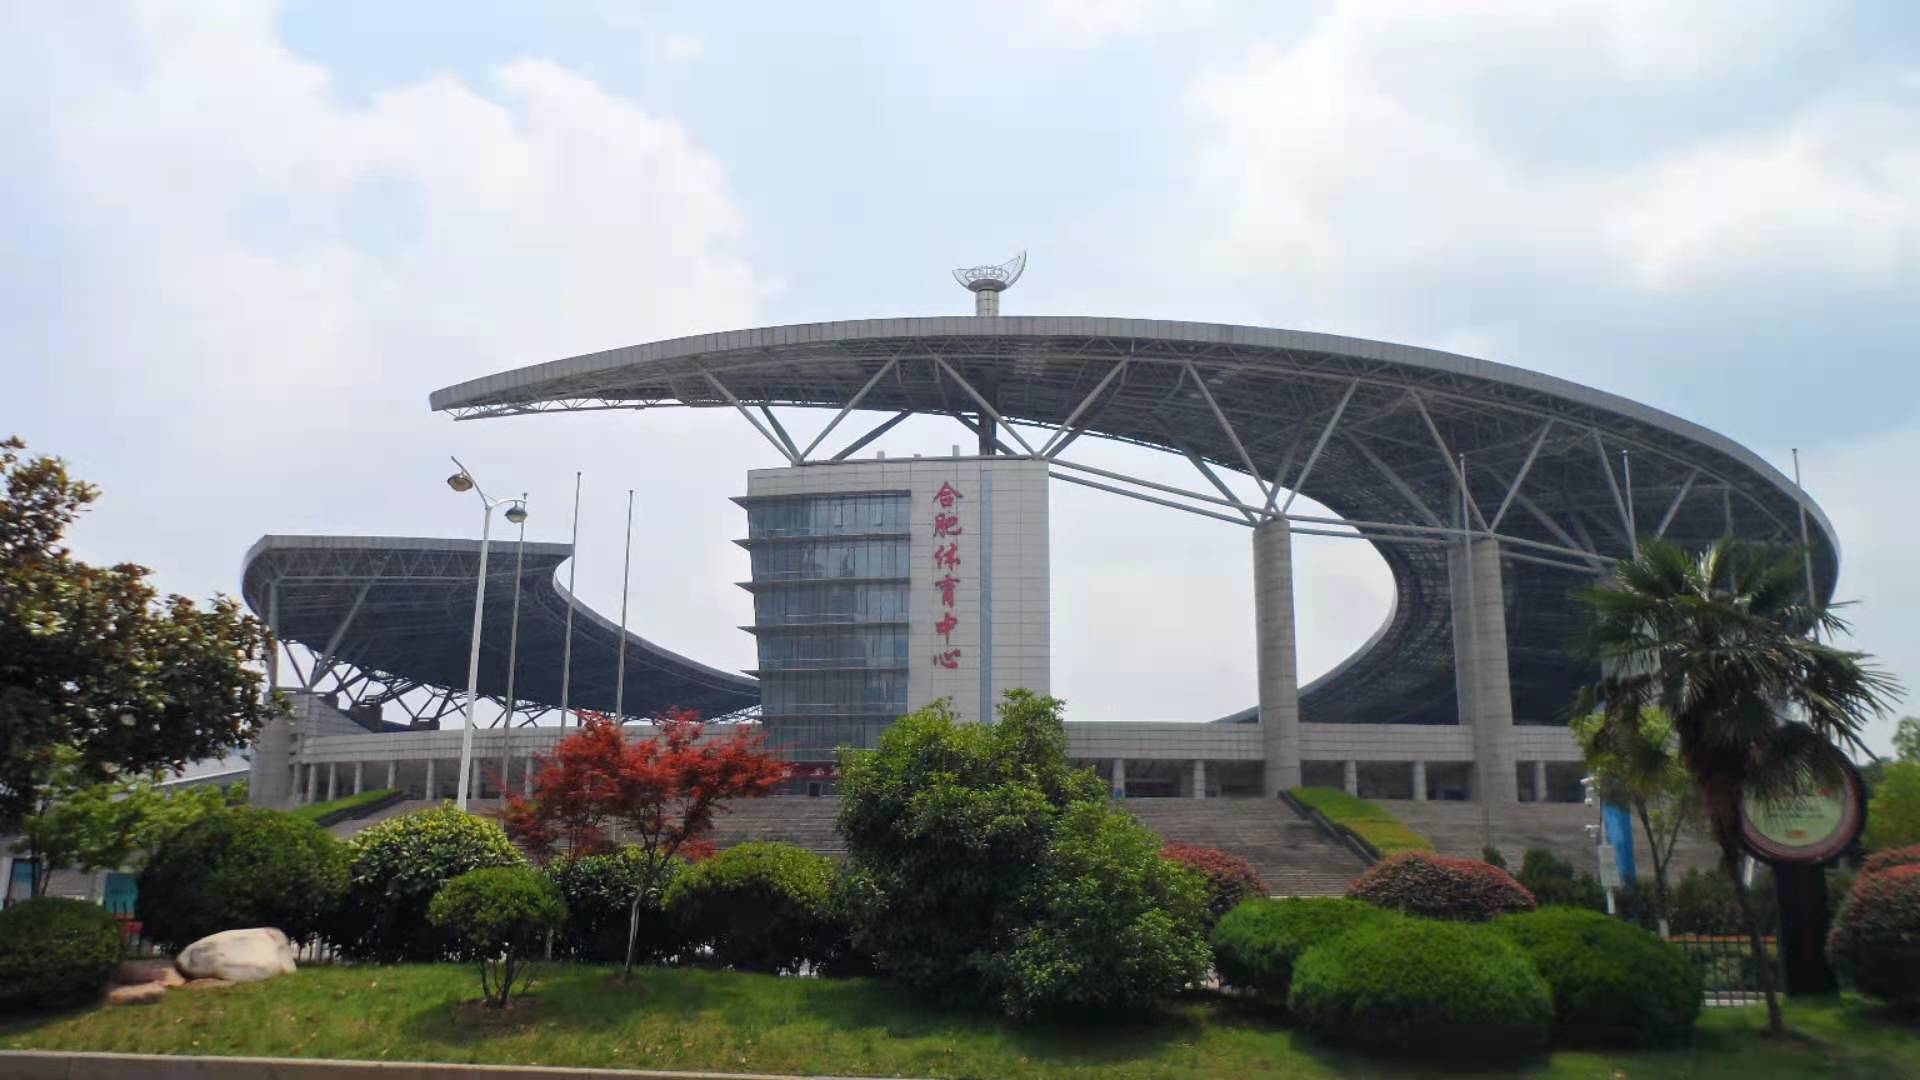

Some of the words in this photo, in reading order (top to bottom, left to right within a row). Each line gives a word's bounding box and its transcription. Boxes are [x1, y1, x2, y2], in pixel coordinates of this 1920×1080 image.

[933, 481, 963, 669] 合肥体育中心
